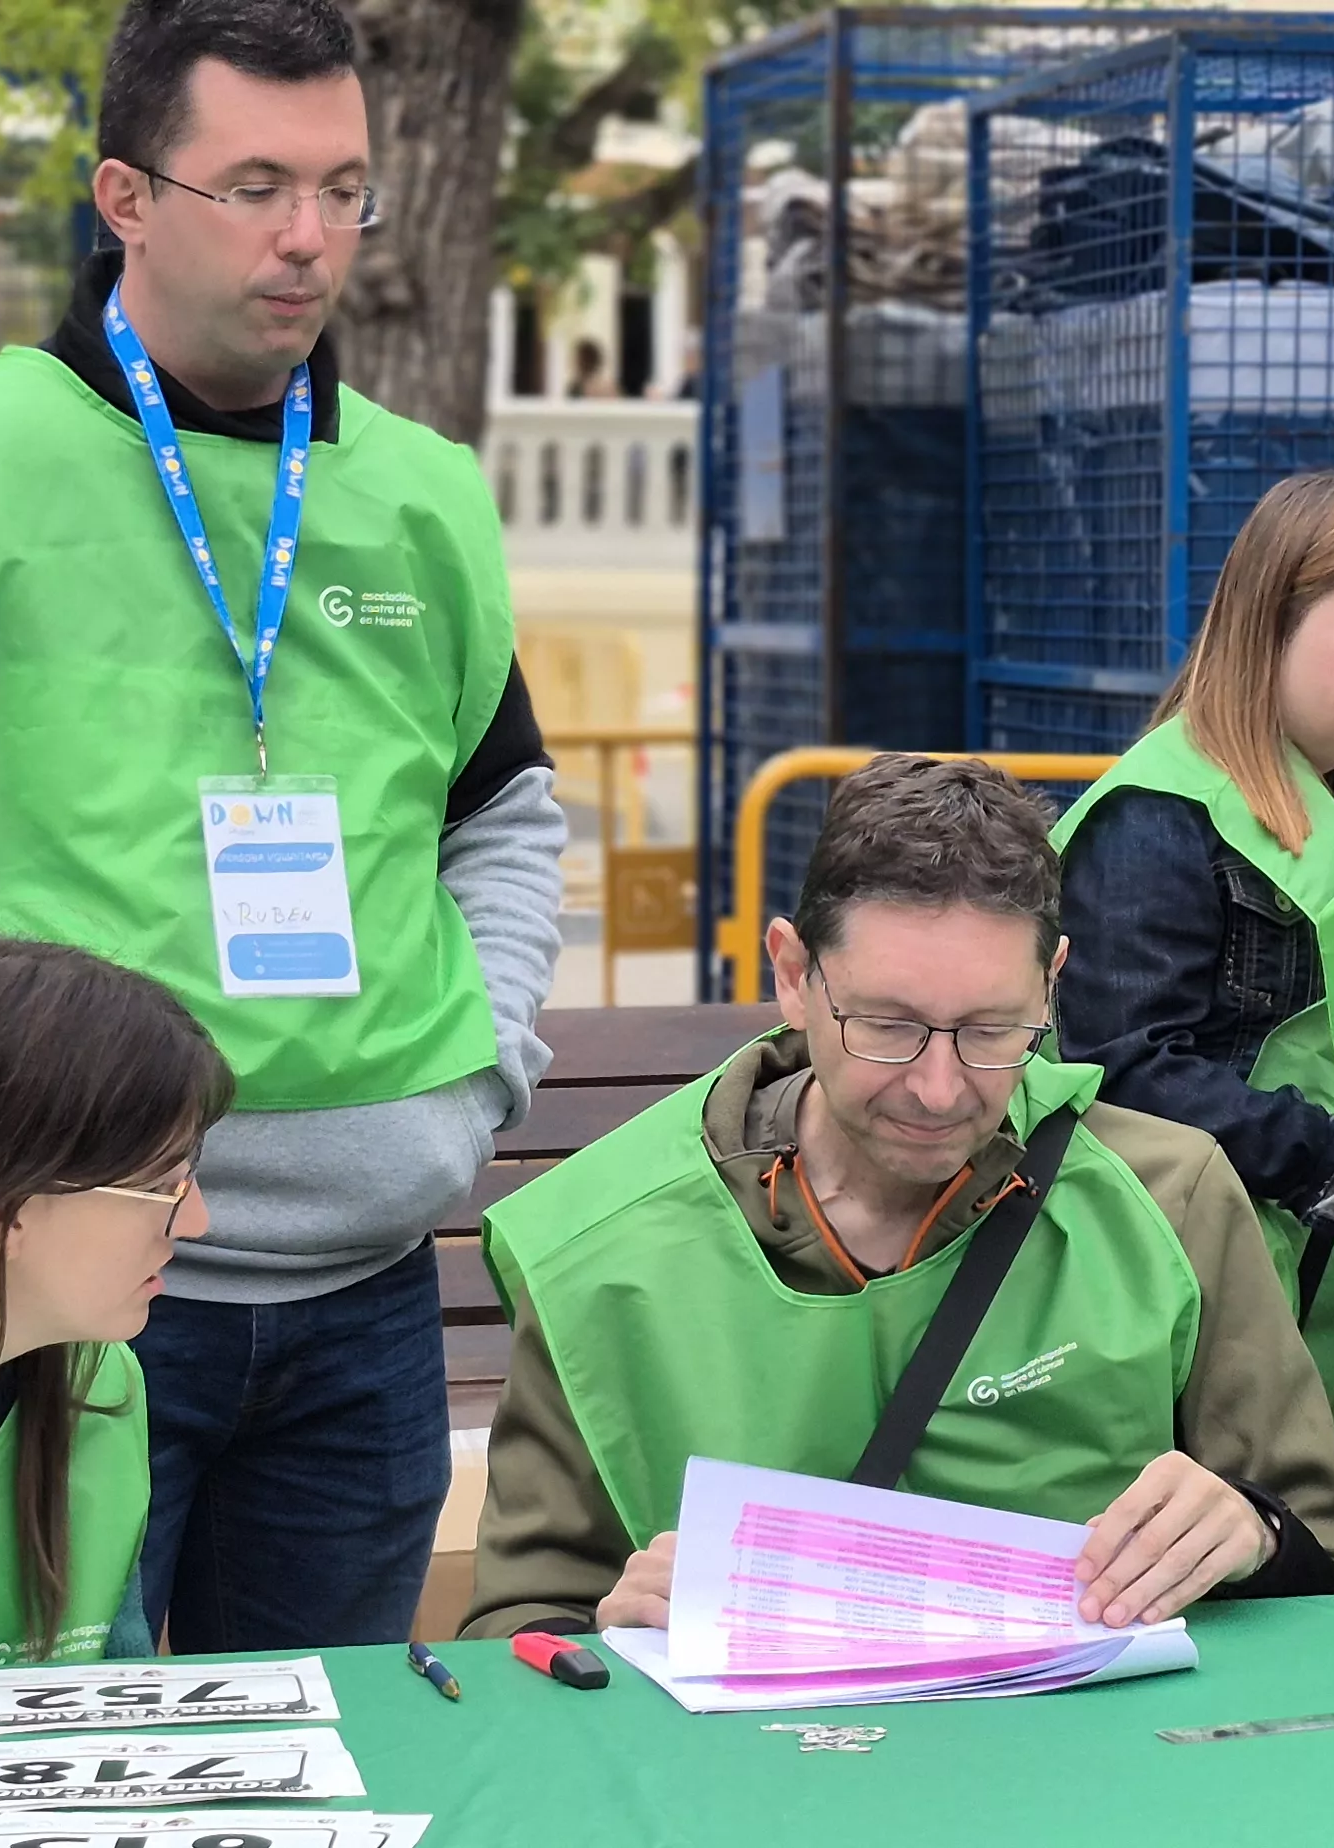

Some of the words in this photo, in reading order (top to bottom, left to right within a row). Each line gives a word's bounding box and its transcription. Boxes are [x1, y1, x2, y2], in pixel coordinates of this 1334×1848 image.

[161, 446, 189, 496] DOWN
[285, 448, 306, 498] DOWN
[271, 537, 294, 587] DOWN
[375, 616, 413, 627] Huesca
[210, 801, 293, 826] DOWN
[13, 1681, 249, 1710] 752
